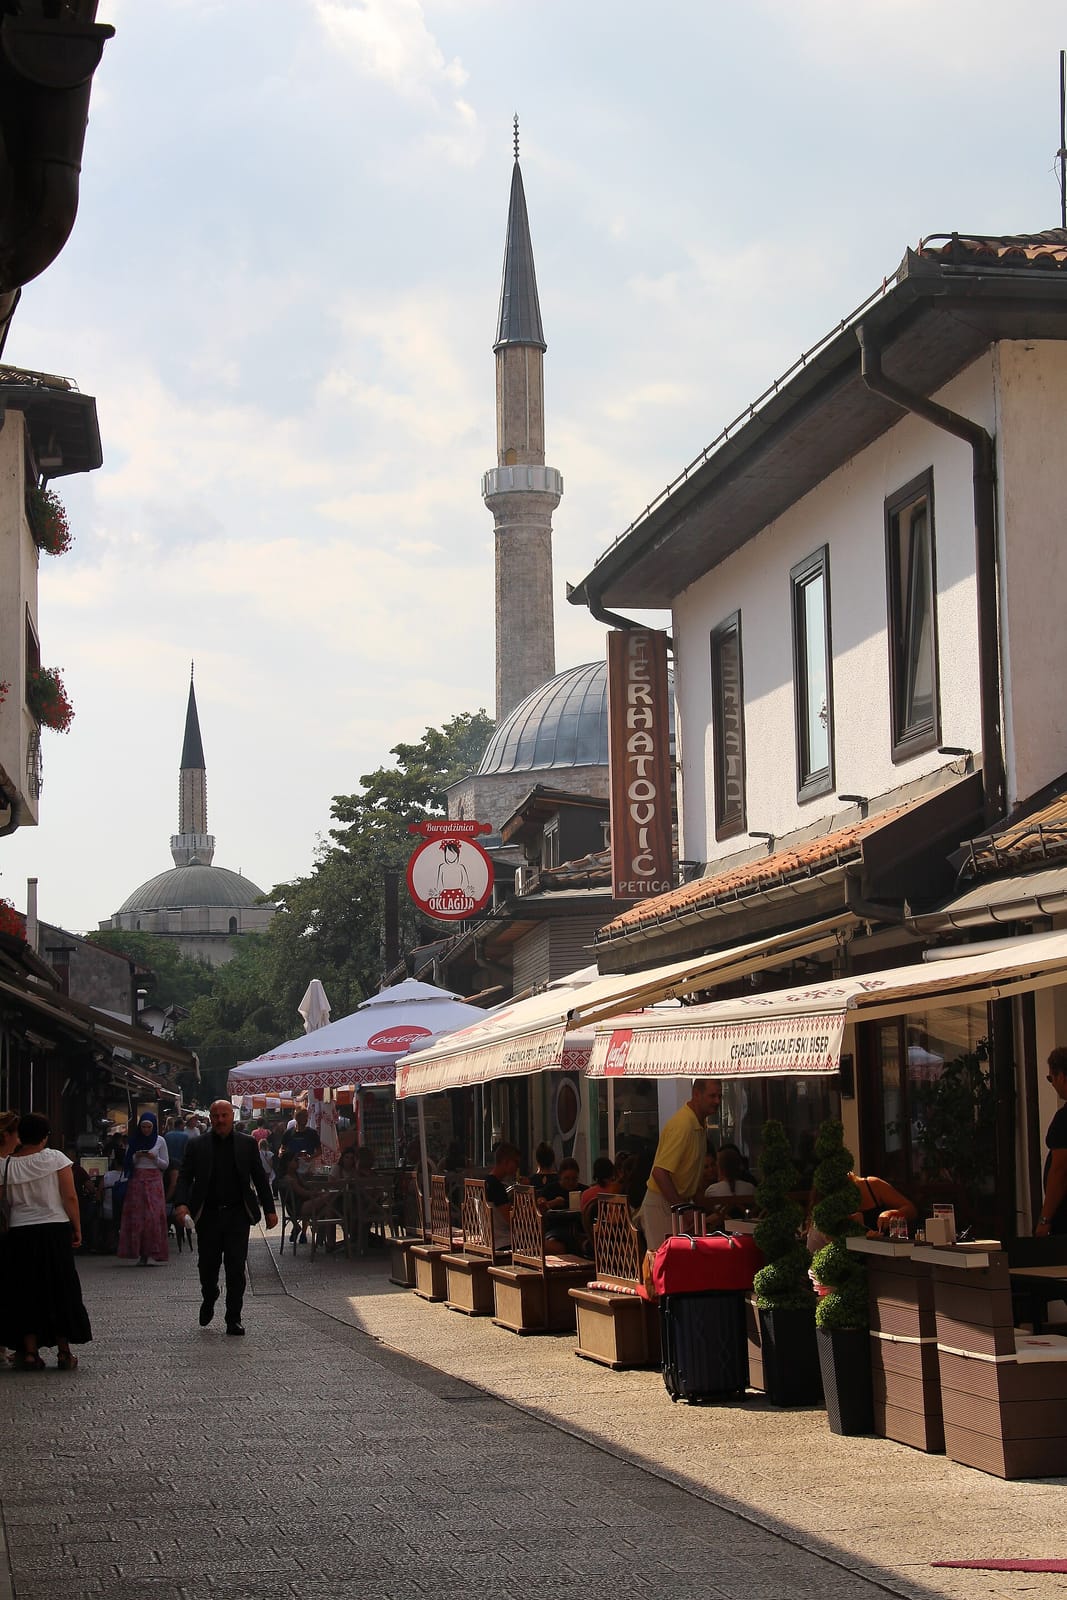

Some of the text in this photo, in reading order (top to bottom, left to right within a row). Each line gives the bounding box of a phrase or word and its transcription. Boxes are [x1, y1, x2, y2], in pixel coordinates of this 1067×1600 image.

[627, 636, 657, 876] FERHATOVIĆ
[618, 880, 671, 893] PETICA
[429, 897, 475, 910] OKLAGIJA
